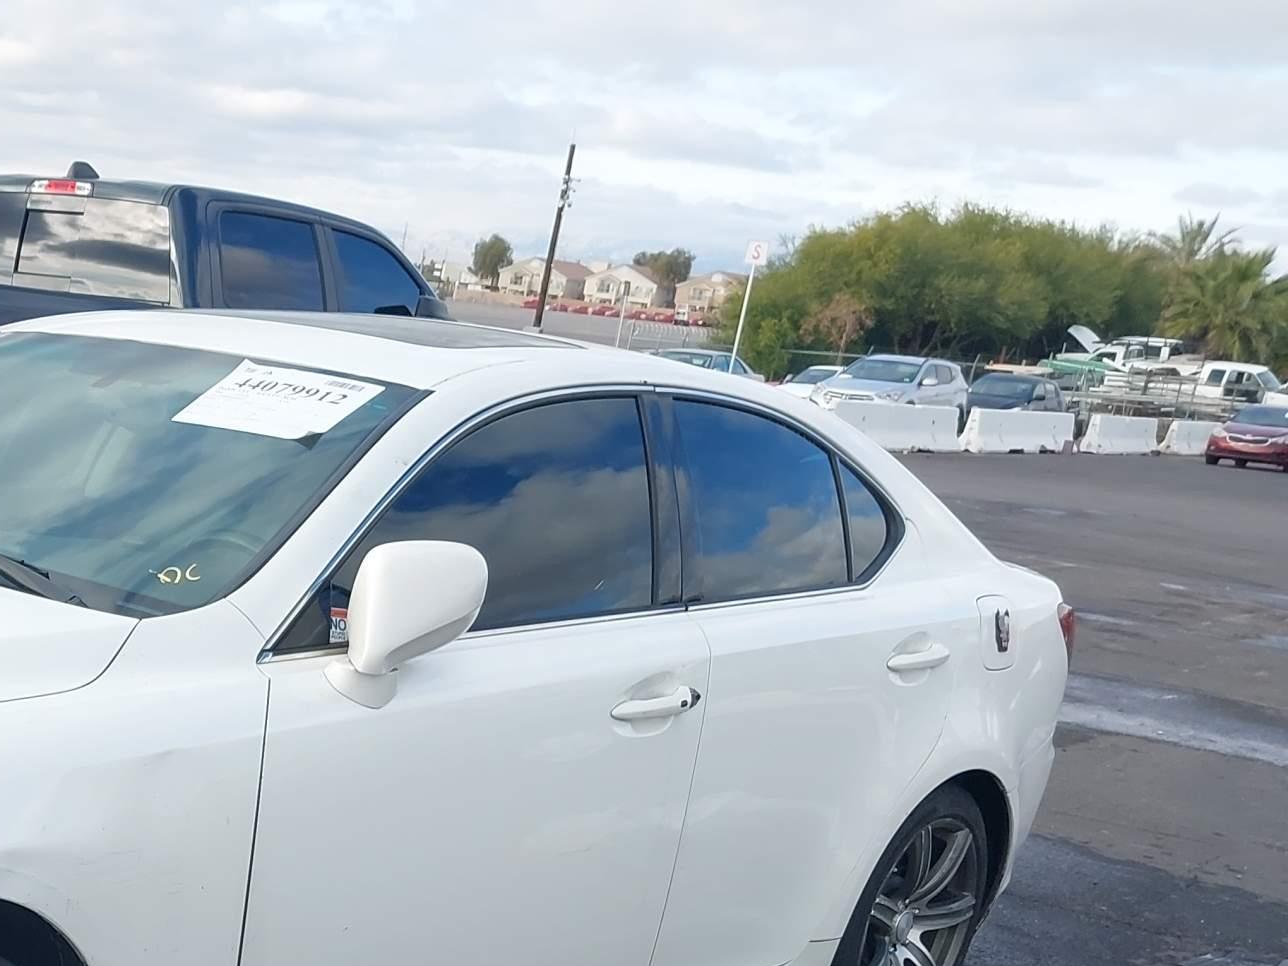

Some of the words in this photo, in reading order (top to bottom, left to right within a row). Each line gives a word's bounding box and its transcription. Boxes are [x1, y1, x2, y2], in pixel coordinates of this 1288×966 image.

[752, 244, 762, 260] S
[234, 377, 348, 406] 44079912
[329, 618, 347, 632] NO
